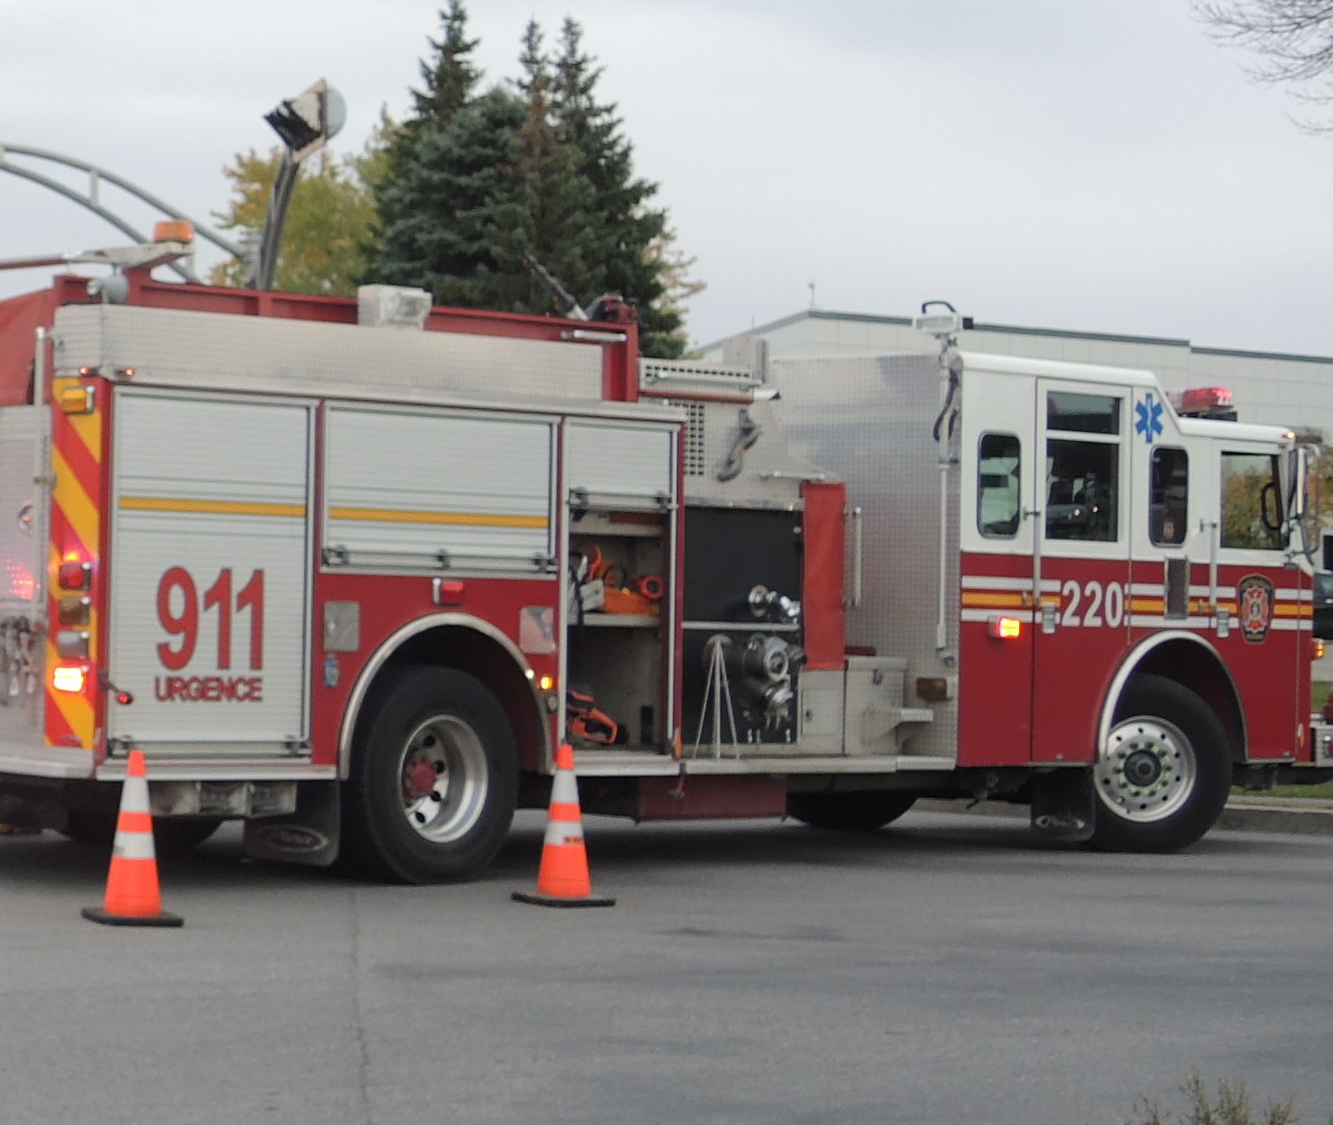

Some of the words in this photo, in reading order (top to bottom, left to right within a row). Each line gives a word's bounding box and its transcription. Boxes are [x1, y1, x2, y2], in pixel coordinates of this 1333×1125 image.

[156, 565, 265, 672] 911
[1061, 579, 1124, 628] 220
[154, 675, 264, 702] URGENCE
